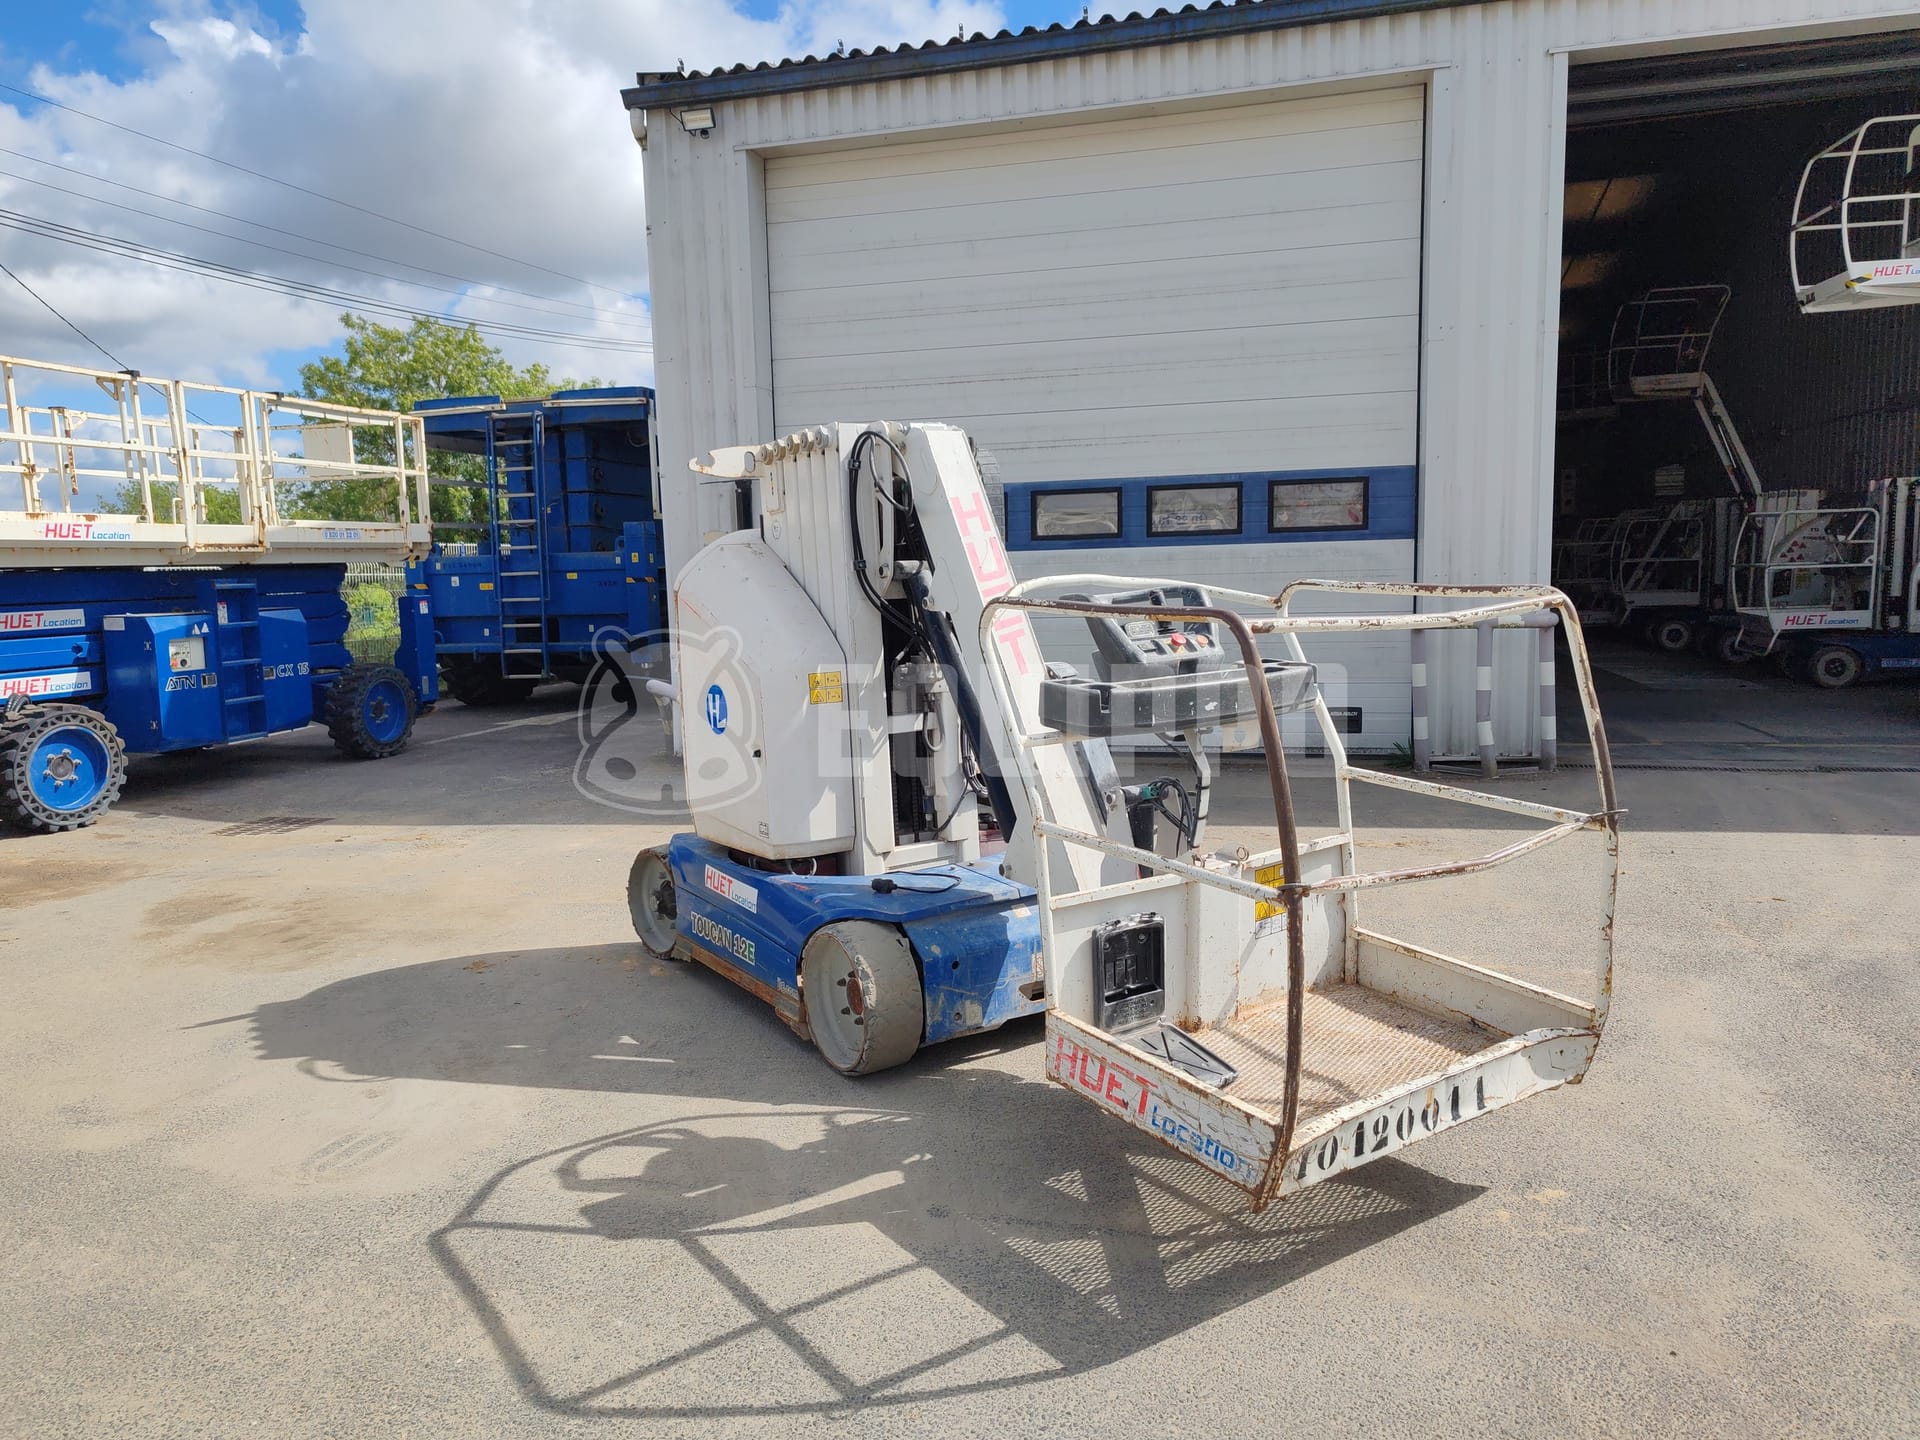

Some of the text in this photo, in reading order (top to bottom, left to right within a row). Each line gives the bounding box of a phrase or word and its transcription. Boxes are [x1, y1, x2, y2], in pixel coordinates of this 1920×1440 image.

[1873, 264, 1912, 277] HUET
[44, 523, 131, 540] HUET Location
[0, 613, 82, 629] HUET Location
[1784, 614, 1828, 626] HUET
[276, 661, 310, 677] CX 15
[3, 677, 89, 696] HUET Location
[165, 674, 197, 692] ATN
[705, 867, 757, 913] HUET Location
[690, 911, 756, 966] TOUCAN 12E
[1054, 1035, 1256, 1180] HUET Location
